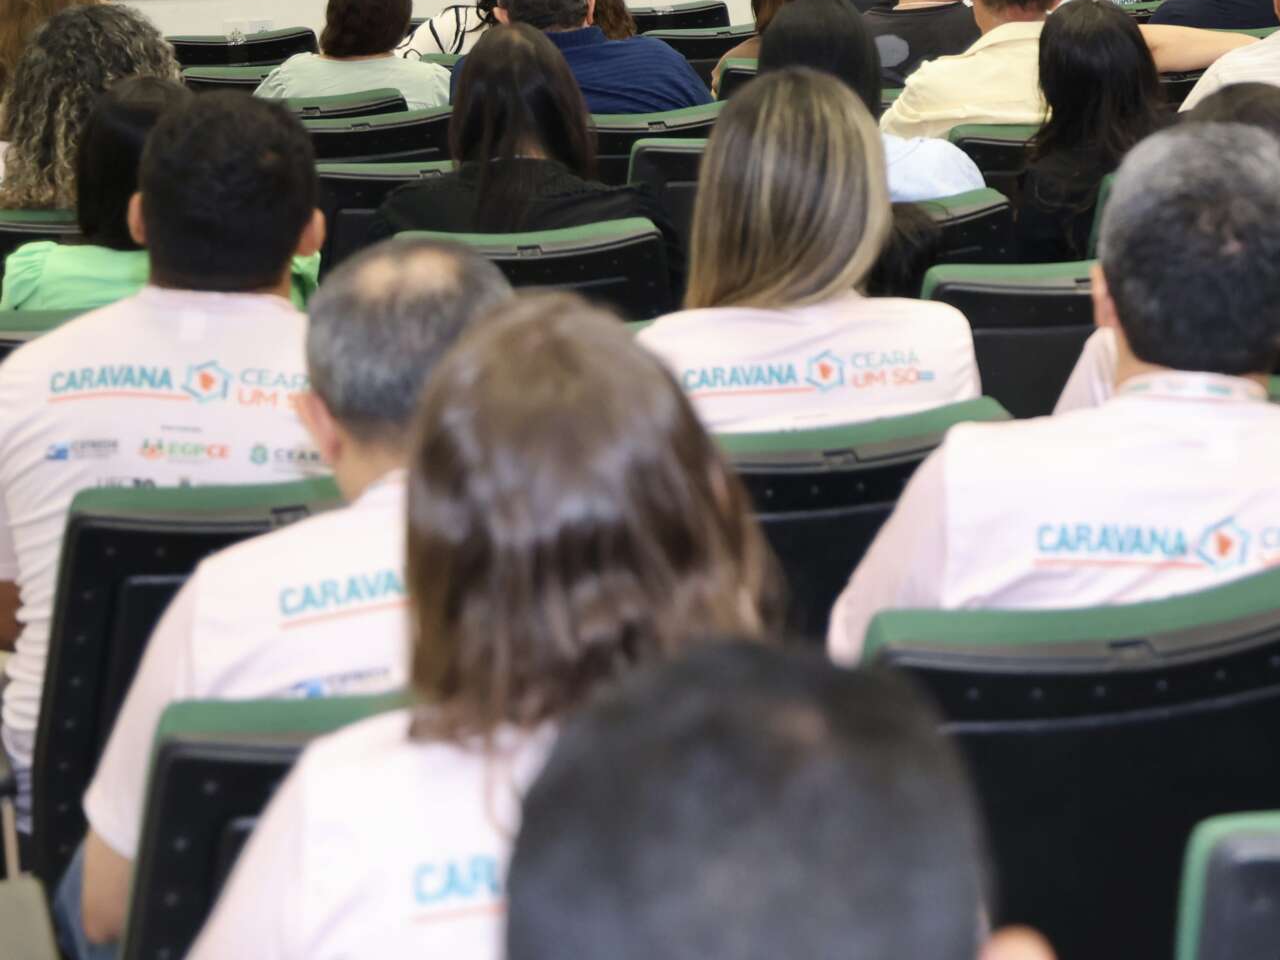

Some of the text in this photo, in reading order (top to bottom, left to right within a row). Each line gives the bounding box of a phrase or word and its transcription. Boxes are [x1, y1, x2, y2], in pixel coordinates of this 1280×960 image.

[50, 364, 172, 394] CARAVANA
[239, 367, 312, 388] CEAR
[684, 363, 796, 389] CARAVANA
[238, 388, 278, 407] UM
[1038, 522, 1188, 556] CARAVANA
[279, 569, 406, 616] CARAVA
